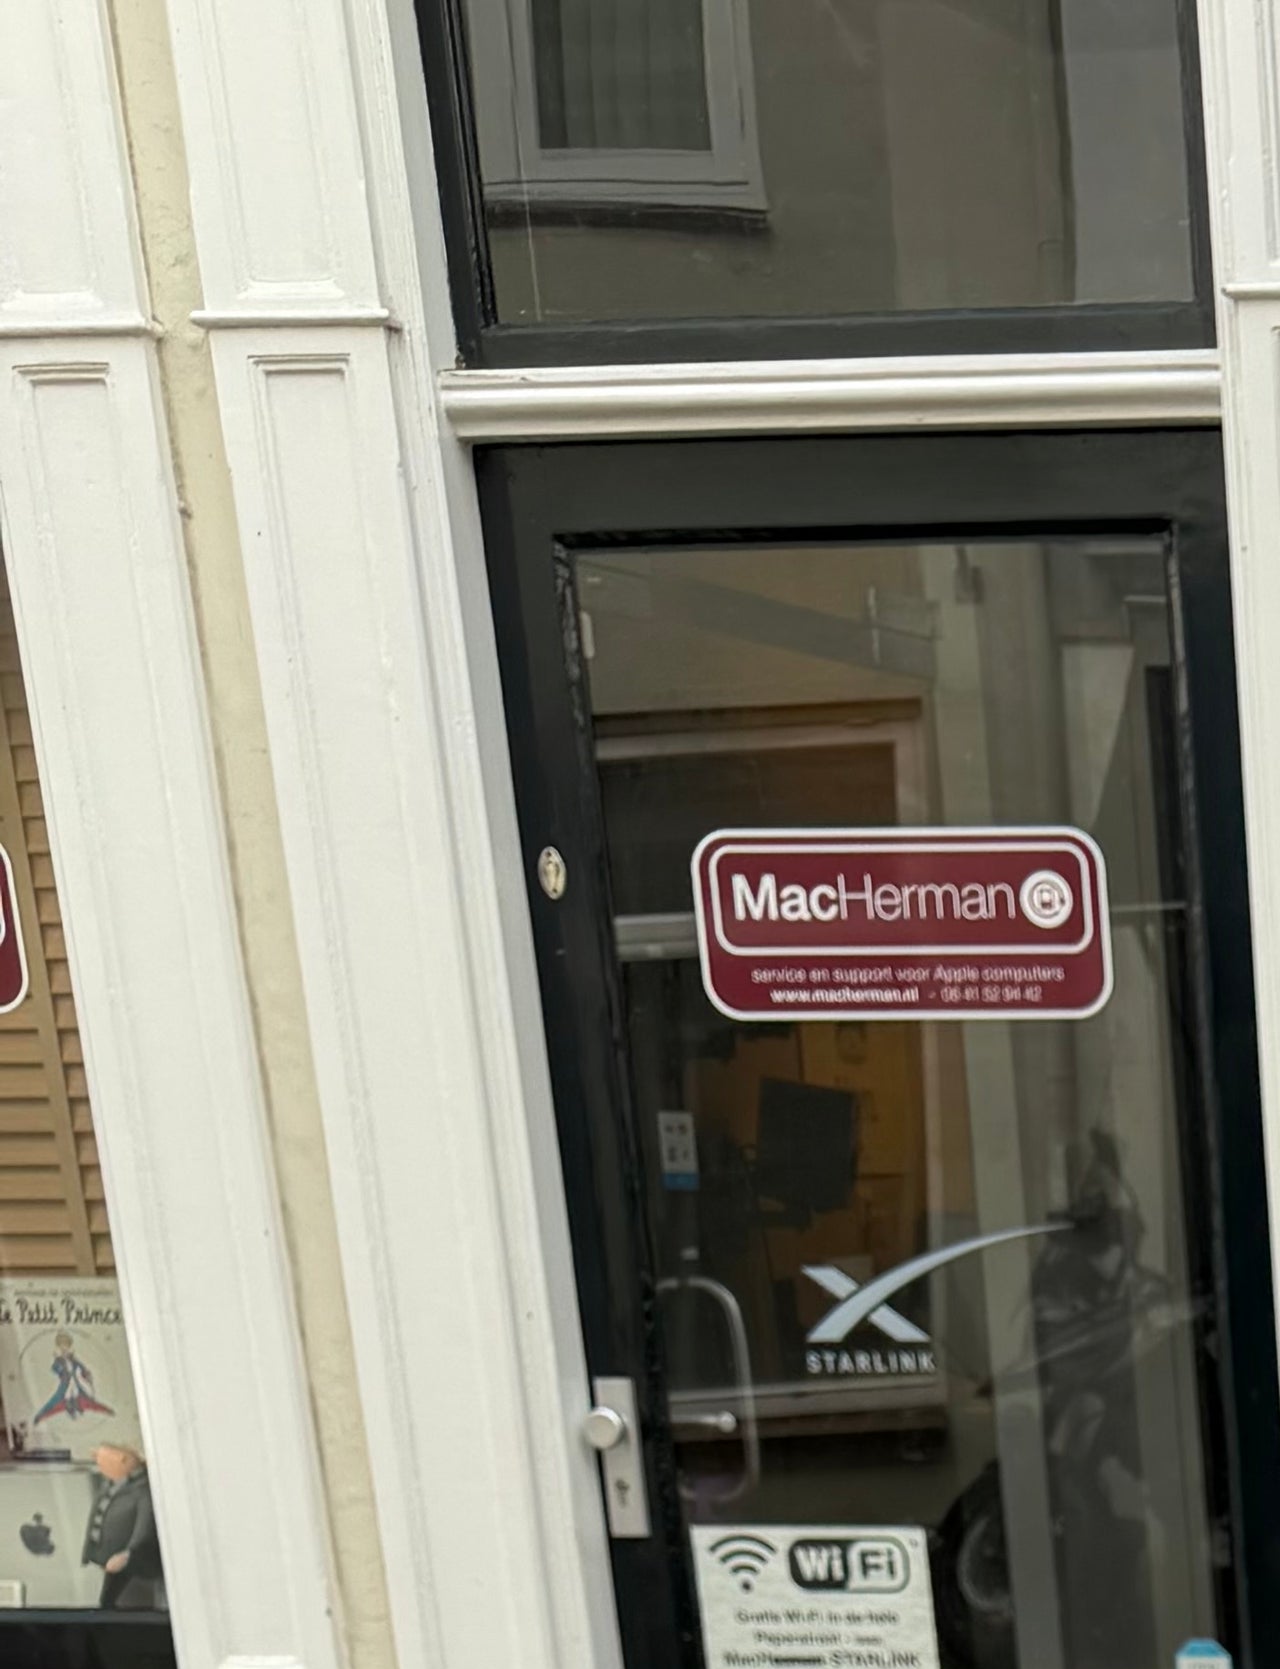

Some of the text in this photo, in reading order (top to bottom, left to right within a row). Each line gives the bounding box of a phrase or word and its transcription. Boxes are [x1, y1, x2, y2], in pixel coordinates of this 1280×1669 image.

[731, 871, 1016, 921] MacHerman
[751, 964, 1065, 984] service en support voor Apple computers
[16, 1298, 58, 1325] Petit
[806, 1349, 937, 1374] STARLINK
